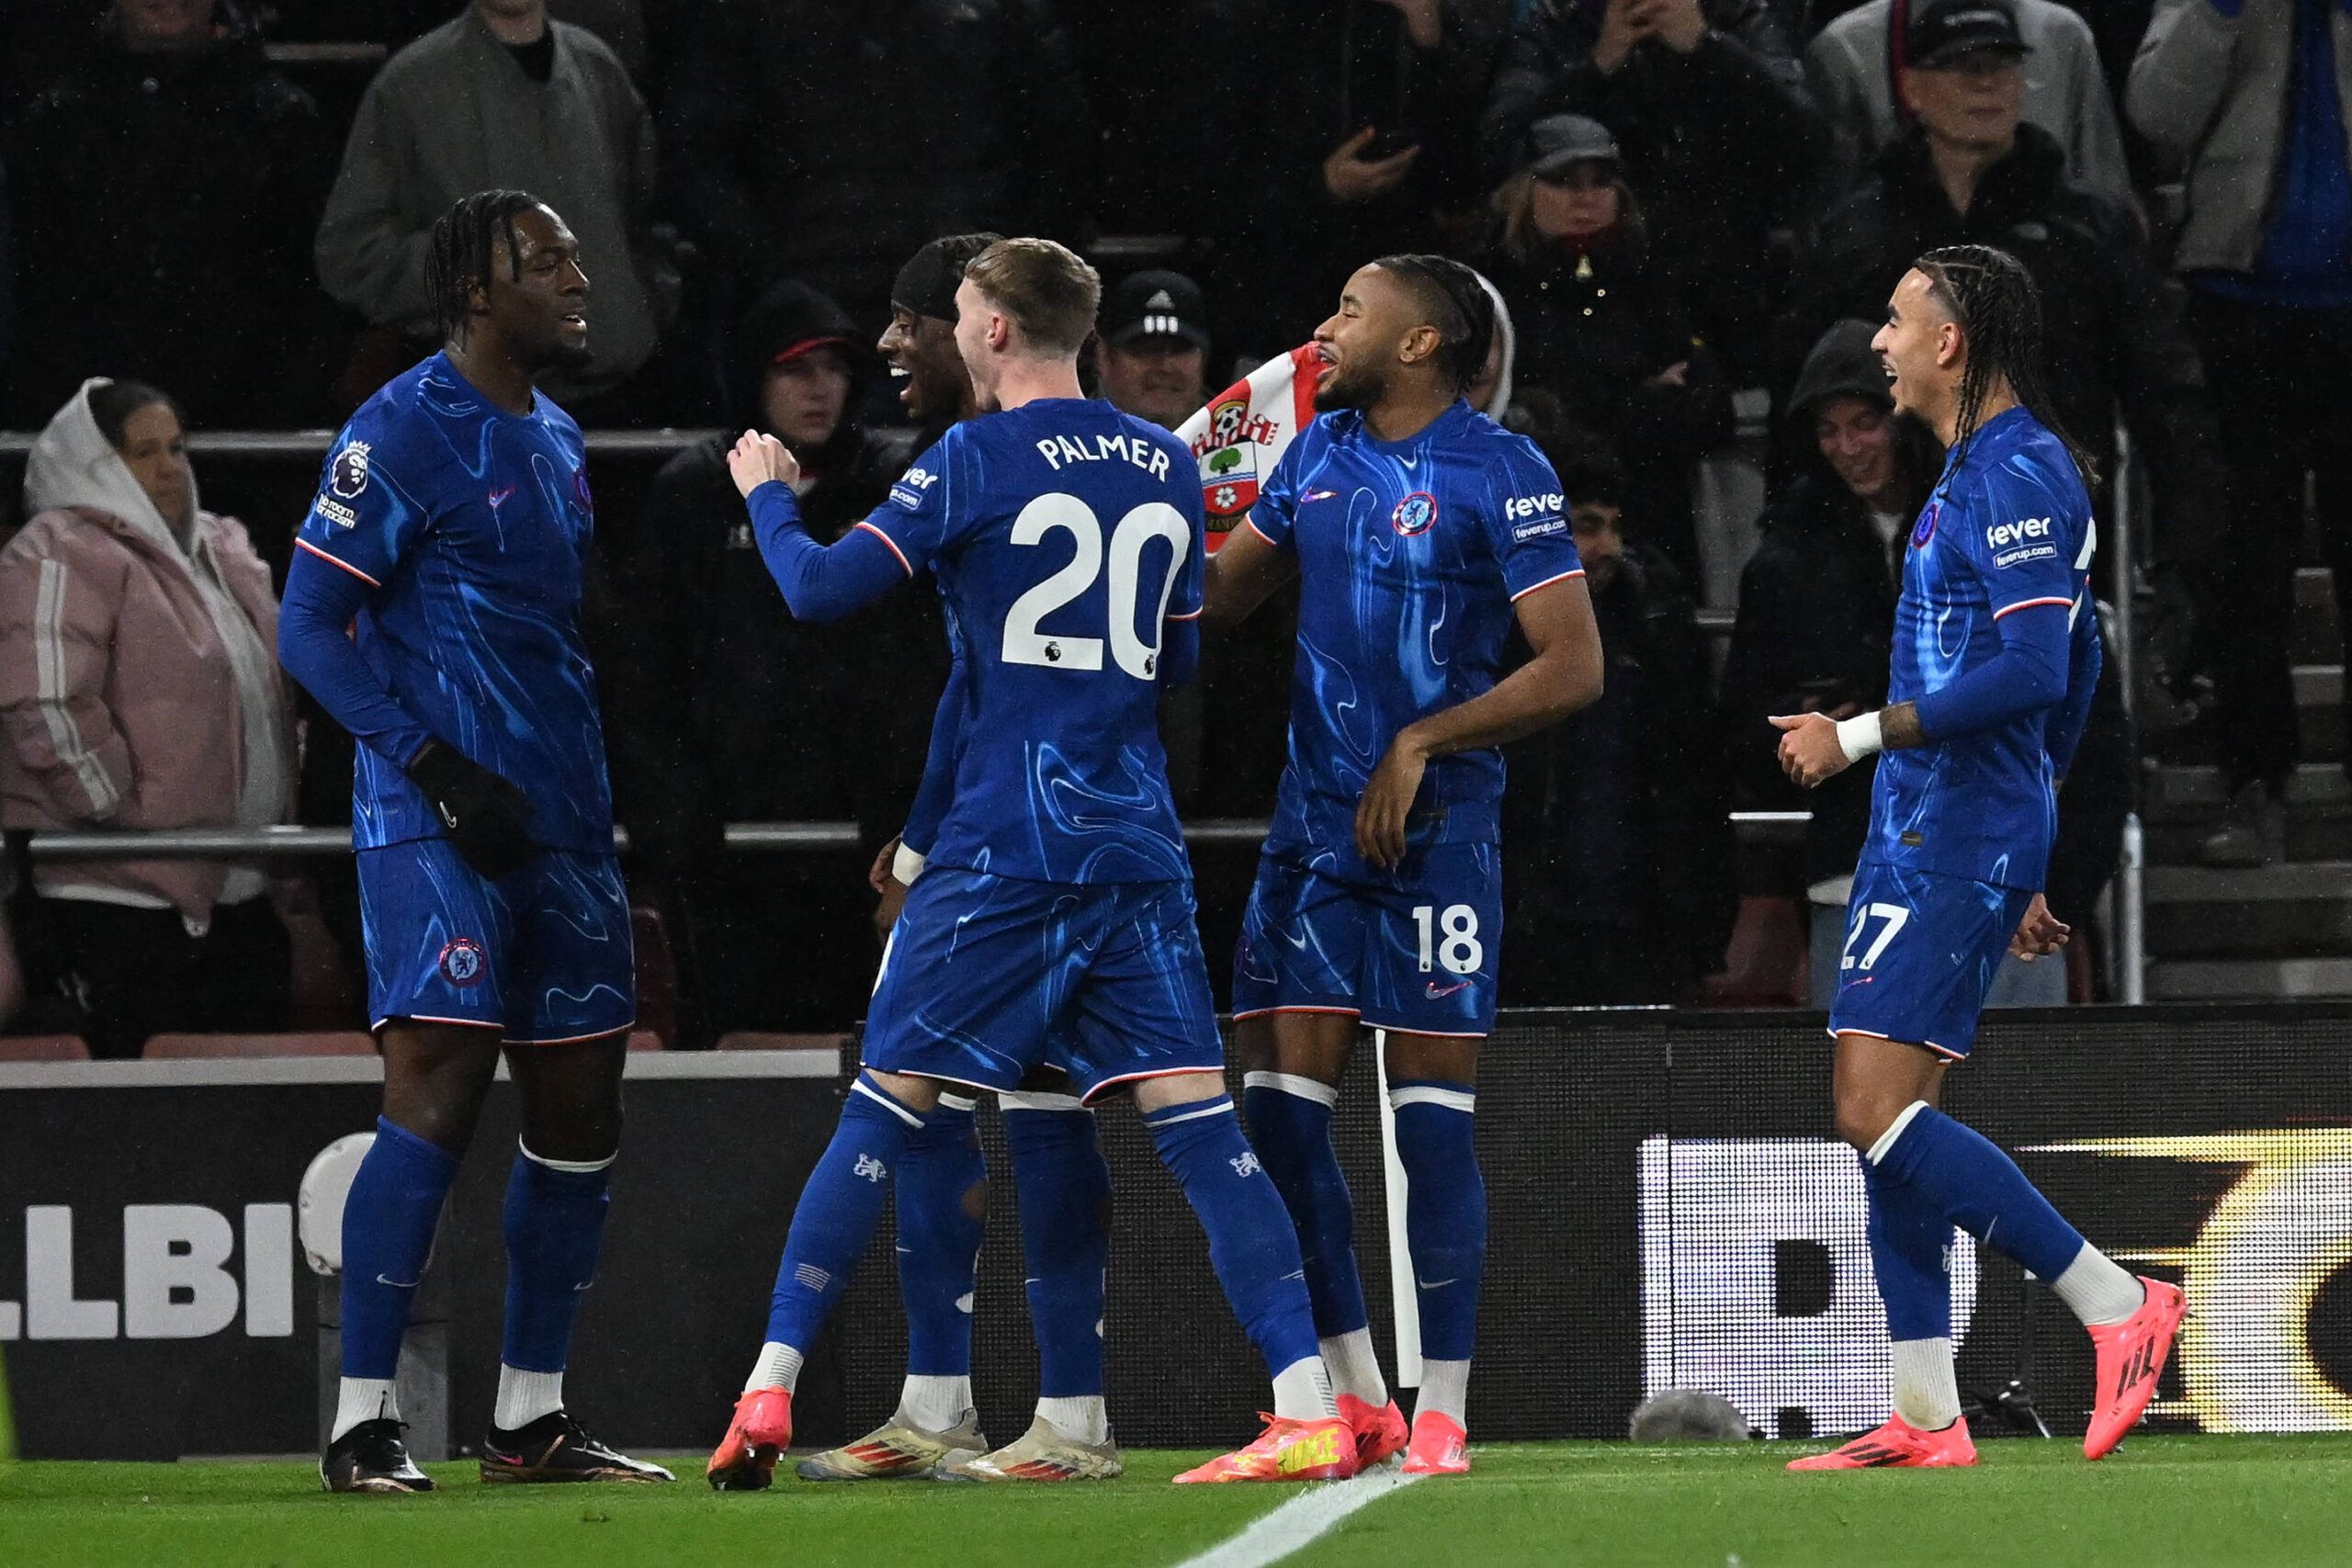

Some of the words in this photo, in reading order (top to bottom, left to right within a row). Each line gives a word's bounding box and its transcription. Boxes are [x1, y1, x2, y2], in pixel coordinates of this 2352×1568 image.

[901, 468, 938, 490] ver
[1036, 434, 1170, 483] PALMER
[328, 500, 355, 519] room
[1986, 516, 2052, 549] fever
[1996, 546, 2054, 567] feverup.com
[1001, 492, 1192, 682] 20
[1412, 904, 1484, 975] 18
[1840, 902, 1911, 971] 27
